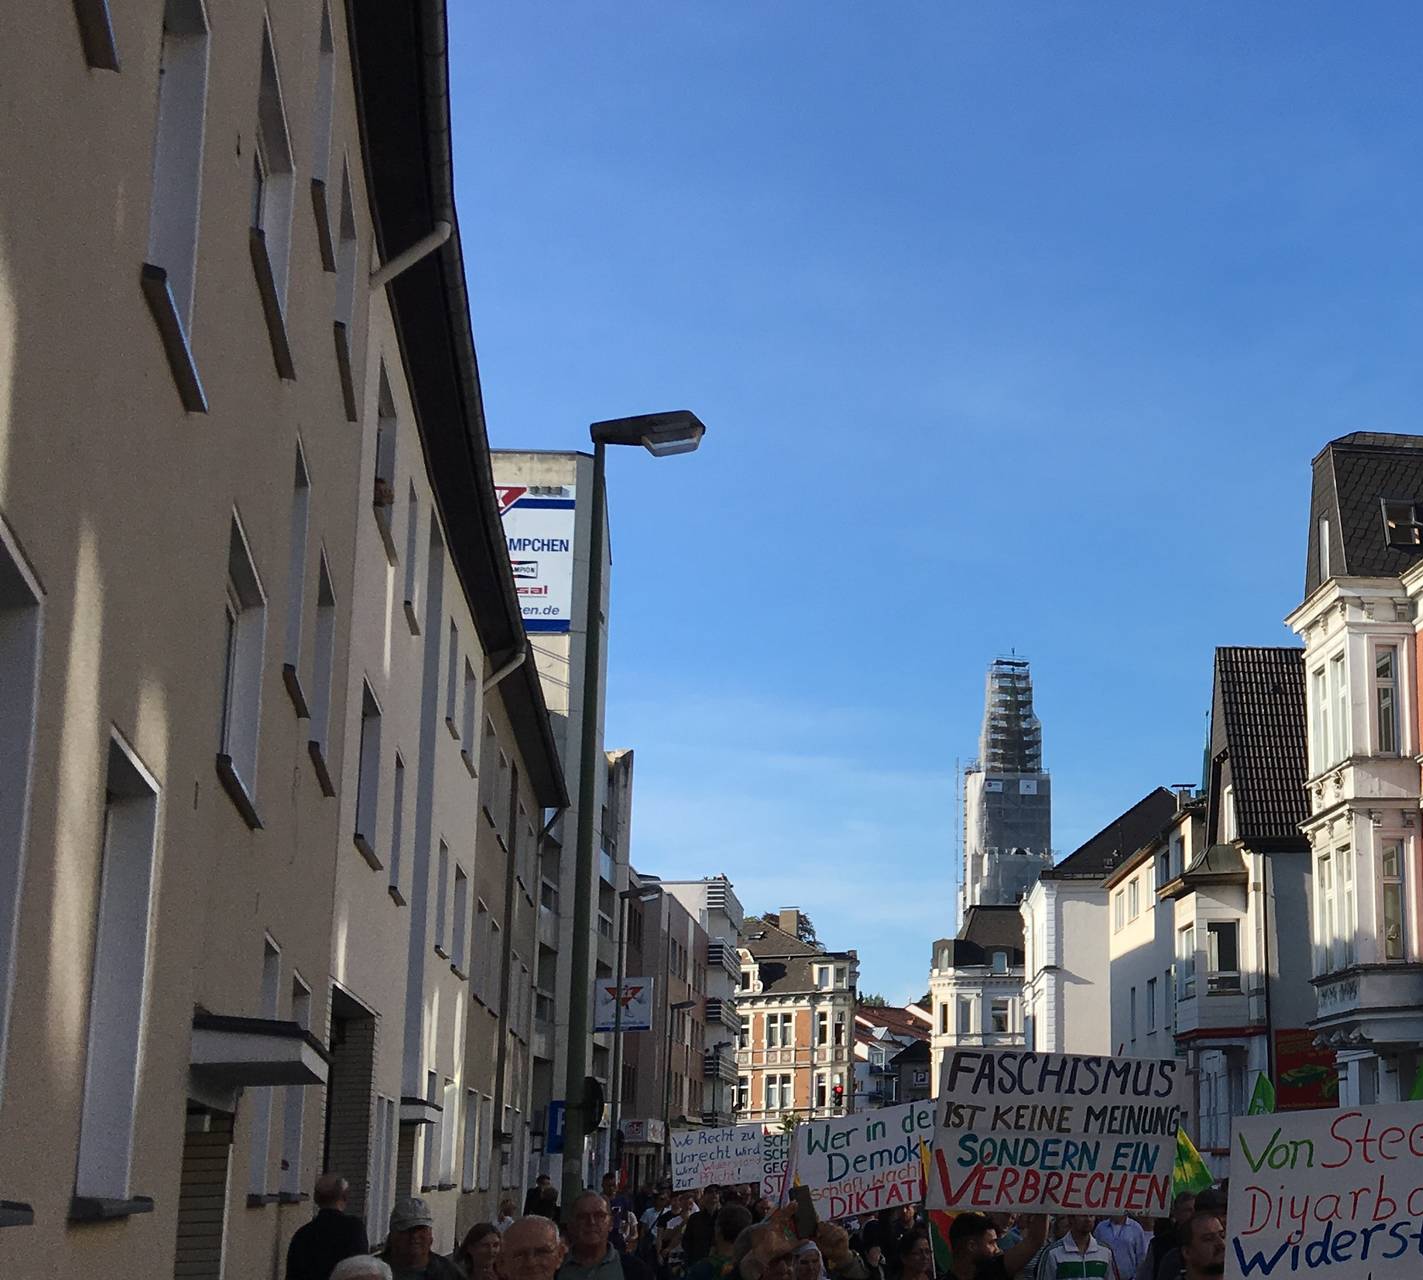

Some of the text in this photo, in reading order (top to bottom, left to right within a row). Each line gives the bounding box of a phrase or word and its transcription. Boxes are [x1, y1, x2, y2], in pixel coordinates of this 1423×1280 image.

[508, 538, 569, 552] MPCHEN
[521, 605, 560, 615] en.de
[947, 1051, 1176, 1098] FASCHISMUS
[698, 1128, 734, 1145] Recht
[741, 1131, 755, 1141] zu
[807, 1124, 859, 1155] Wer
[866, 1117, 886, 1142] in
[943, 1101, 1181, 1138] IST KEINE MEINUNG
[674, 1143, 760, 1164] Unrecht wird
[675, 1163, 699, 1175] wird
[827, 1135, 933, 1182] Demok
[957, 1133, 1160, 1174] SONDERN EIN
[1239, 1128, 1315, 1173] Von
[674, 1177, 693, 1189] zur
[935, 1149, 1170, 1210] VERBRECHEN
[830, 1179, 922, 1220] DIKTAT
